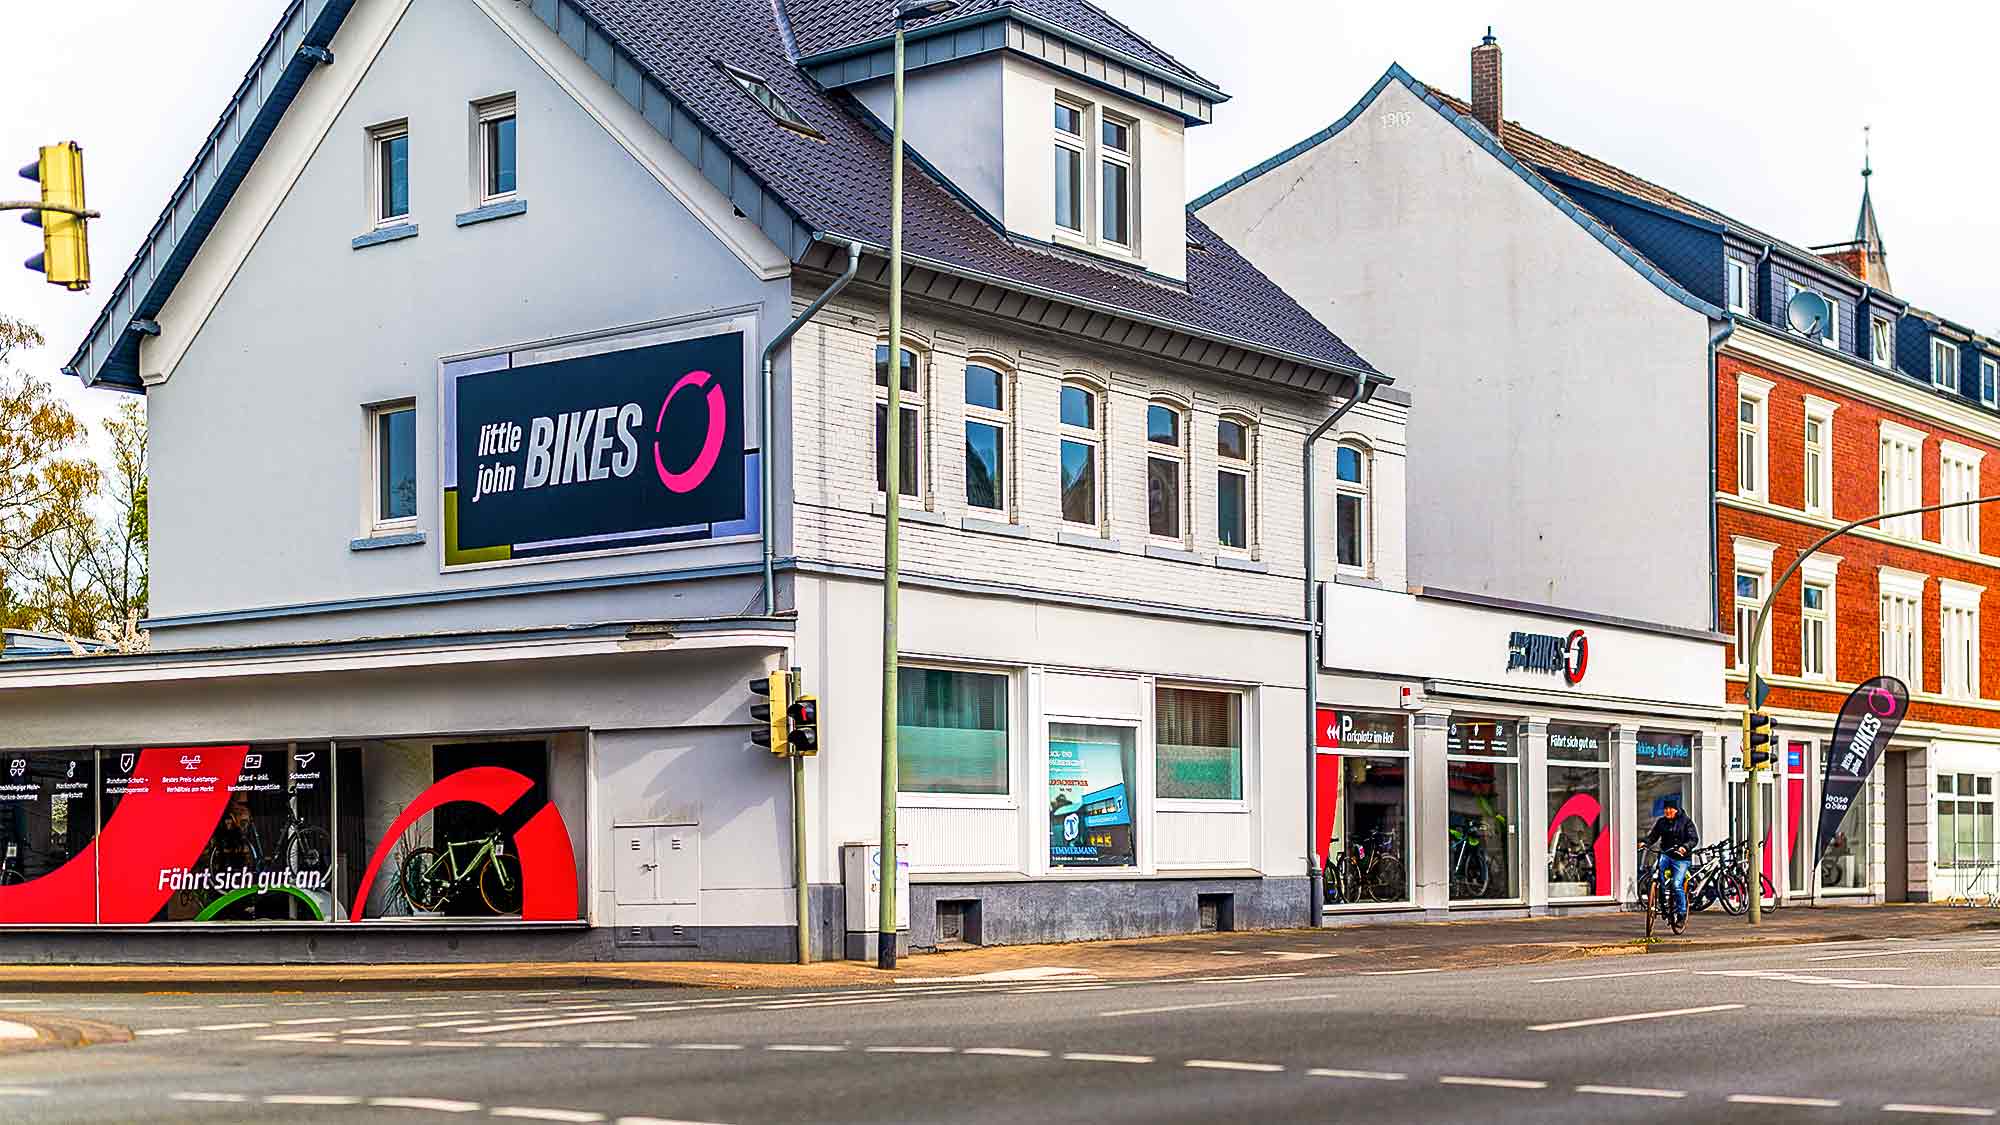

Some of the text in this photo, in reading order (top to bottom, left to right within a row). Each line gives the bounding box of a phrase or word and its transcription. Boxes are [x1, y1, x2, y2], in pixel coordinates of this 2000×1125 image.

[478, 421, 522, 457] little
[523, 402, 643, 489] BIKES
[472, 463, 516, 503] john
[1528, 634, 1565, 672] BIKES
[1342, 715, 1395, 745] Parkplatz im Hof
[1550, 735, 1567, 747] Fährt
[1567, 735, 1578, 748] sich
[1579, 736, 1588, 751] gut
[1849, 712, 1881, 760] BIKES
[1657, 744, 1662, 756] &
[1662, 744, 1689, 759] Cityräder
[1825, 793, 1848, 803] lease
[1051, 846, 1098, 855] TIMMERMANN
[158, 866, 326, 895] Fährt sich gut an.
